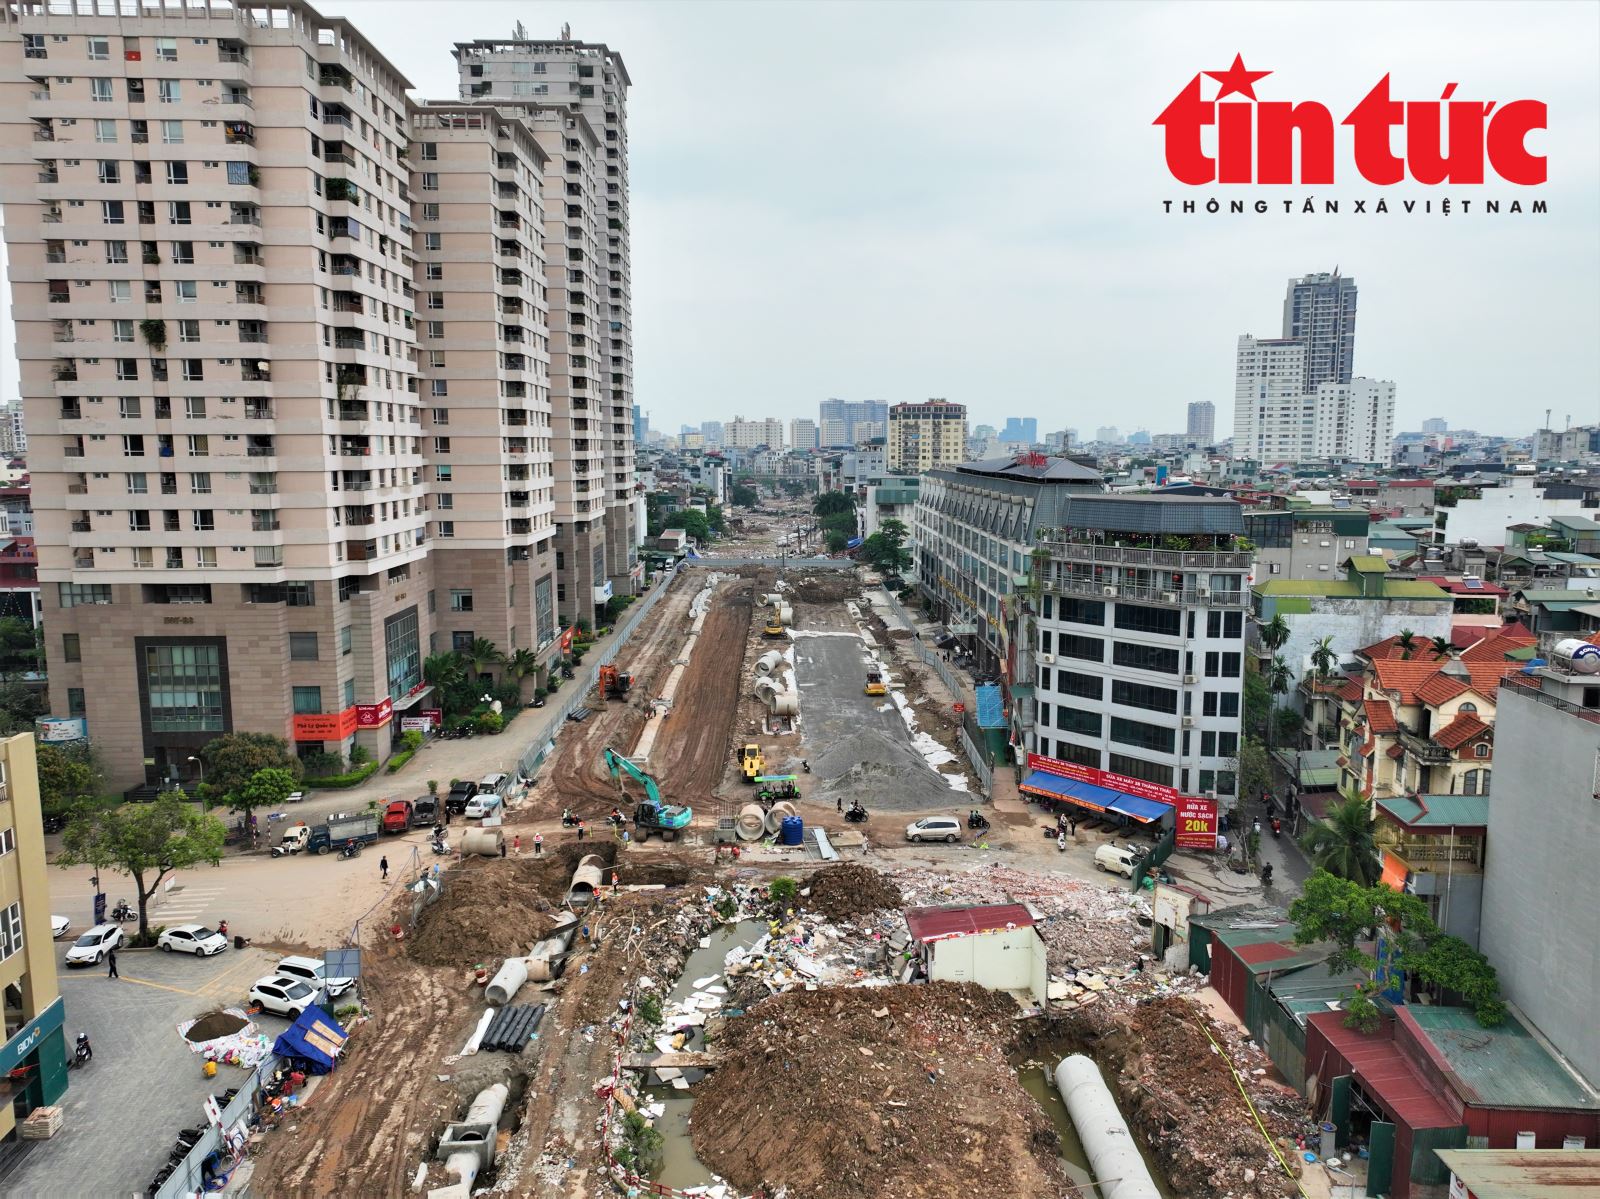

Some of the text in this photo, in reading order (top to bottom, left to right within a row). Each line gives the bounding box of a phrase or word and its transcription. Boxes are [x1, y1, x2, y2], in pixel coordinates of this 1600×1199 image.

[1186, 802, 1199, 810] RỬA
[1185, 819, 1208, 832] 20k
[17, 1031, 35, 1055] BIDV
